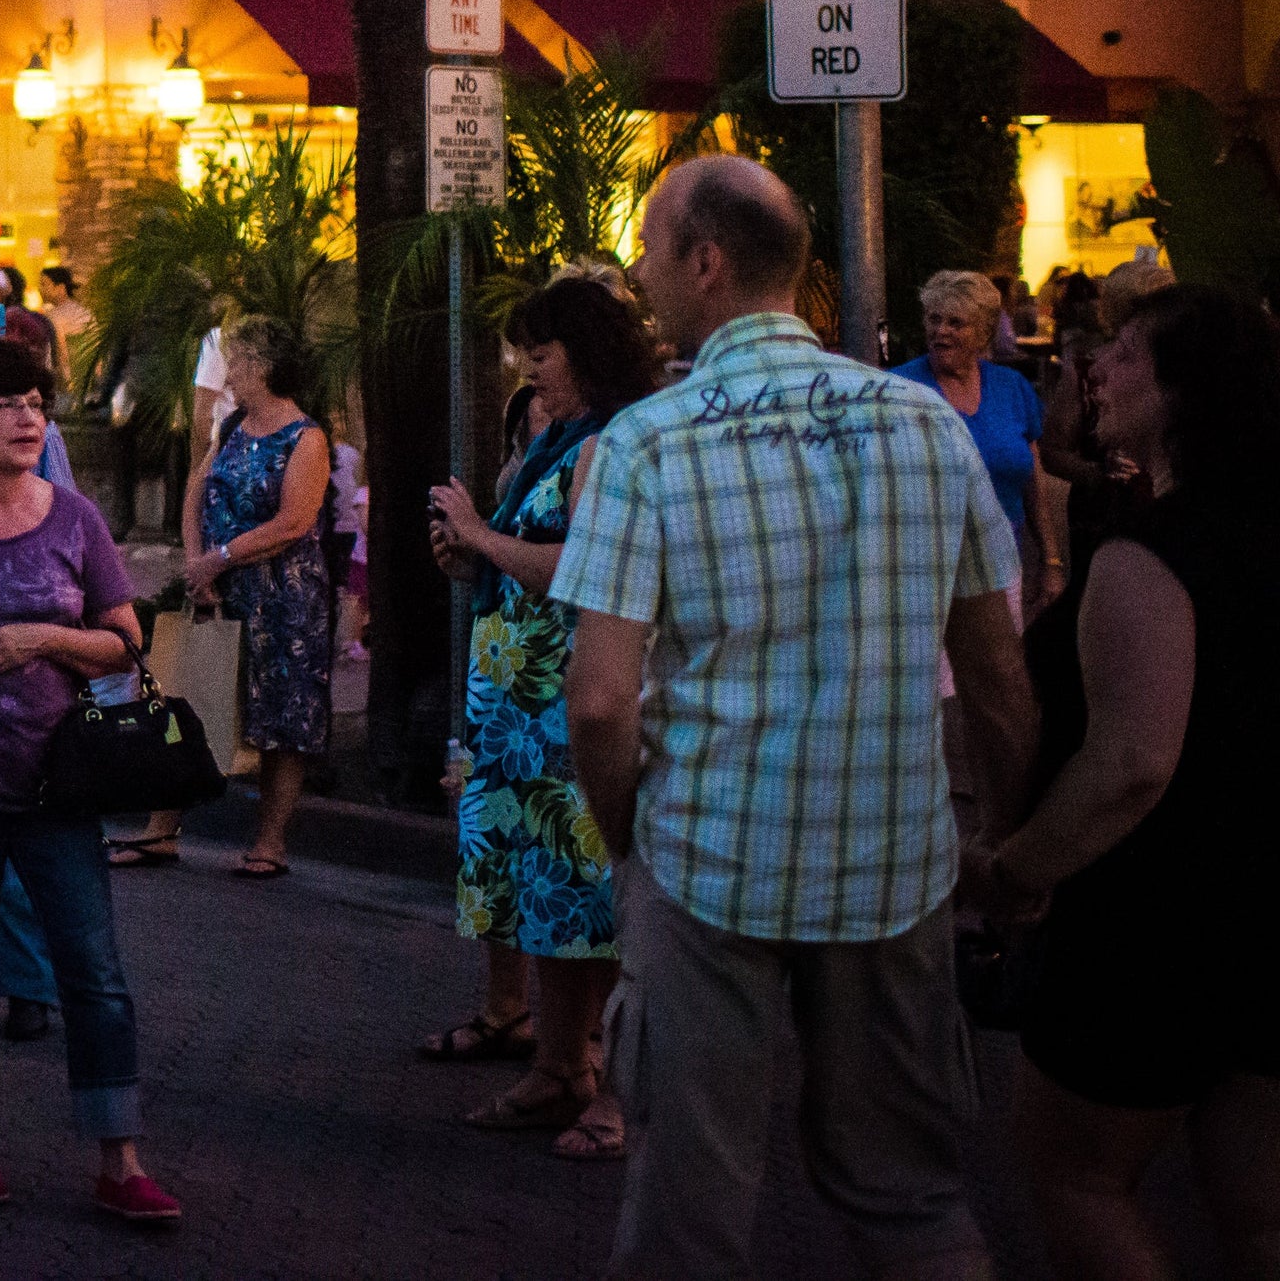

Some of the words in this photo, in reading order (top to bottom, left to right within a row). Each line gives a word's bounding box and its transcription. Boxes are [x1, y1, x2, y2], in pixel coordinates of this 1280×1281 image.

[450, 13, 481, 37] TIME
[817, 4, 853, 33] ON
[811, 47, 861, 75] RED
[455, 77, 478, 94] NO
[456, 119, 478, 136] NO
